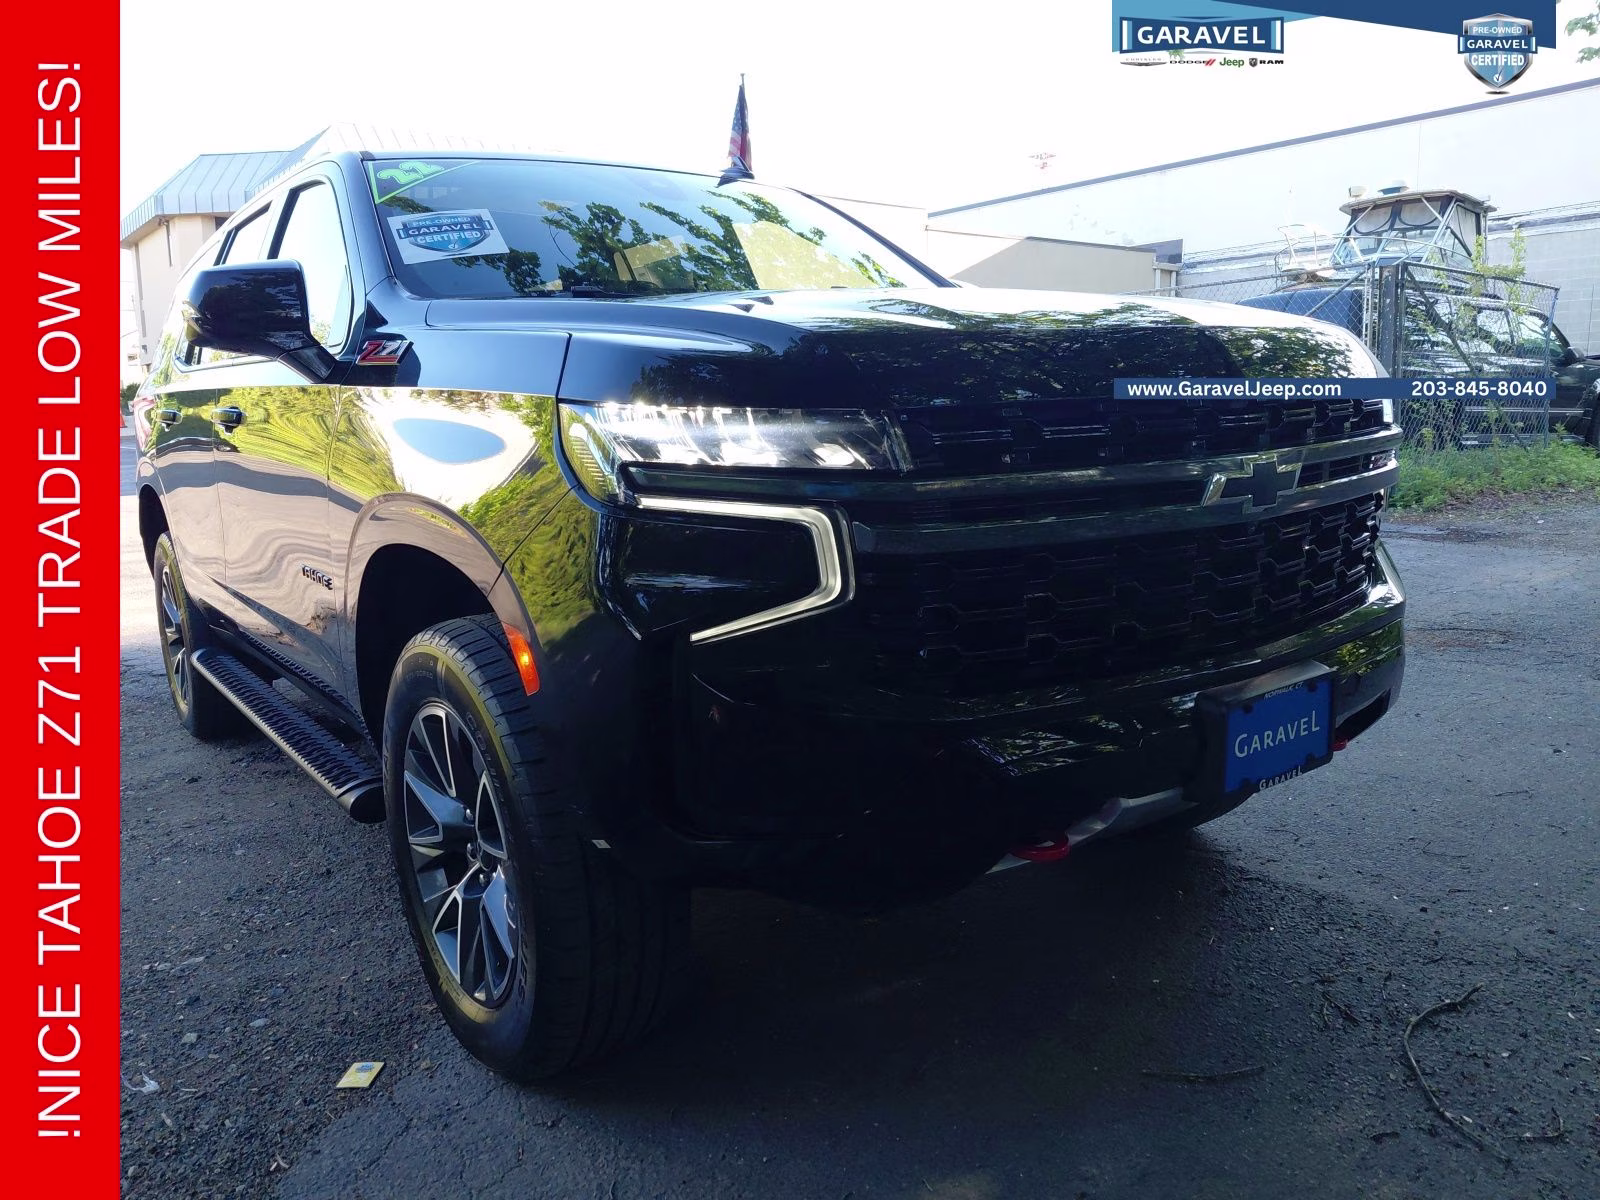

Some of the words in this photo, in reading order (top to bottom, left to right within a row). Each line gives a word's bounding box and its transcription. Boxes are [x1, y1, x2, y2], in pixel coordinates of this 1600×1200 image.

[408, 222, 482, 235] GARAVEL
[411, 216, 472, 227] PRE-OWNED
[416, 230, 481, 244] CERTIFIED
[355, 339, 414, 366] Z71
[1234, 709, 1320, 758] GARAVEL
[1259, 764, 1303, 791] GARAVEL
